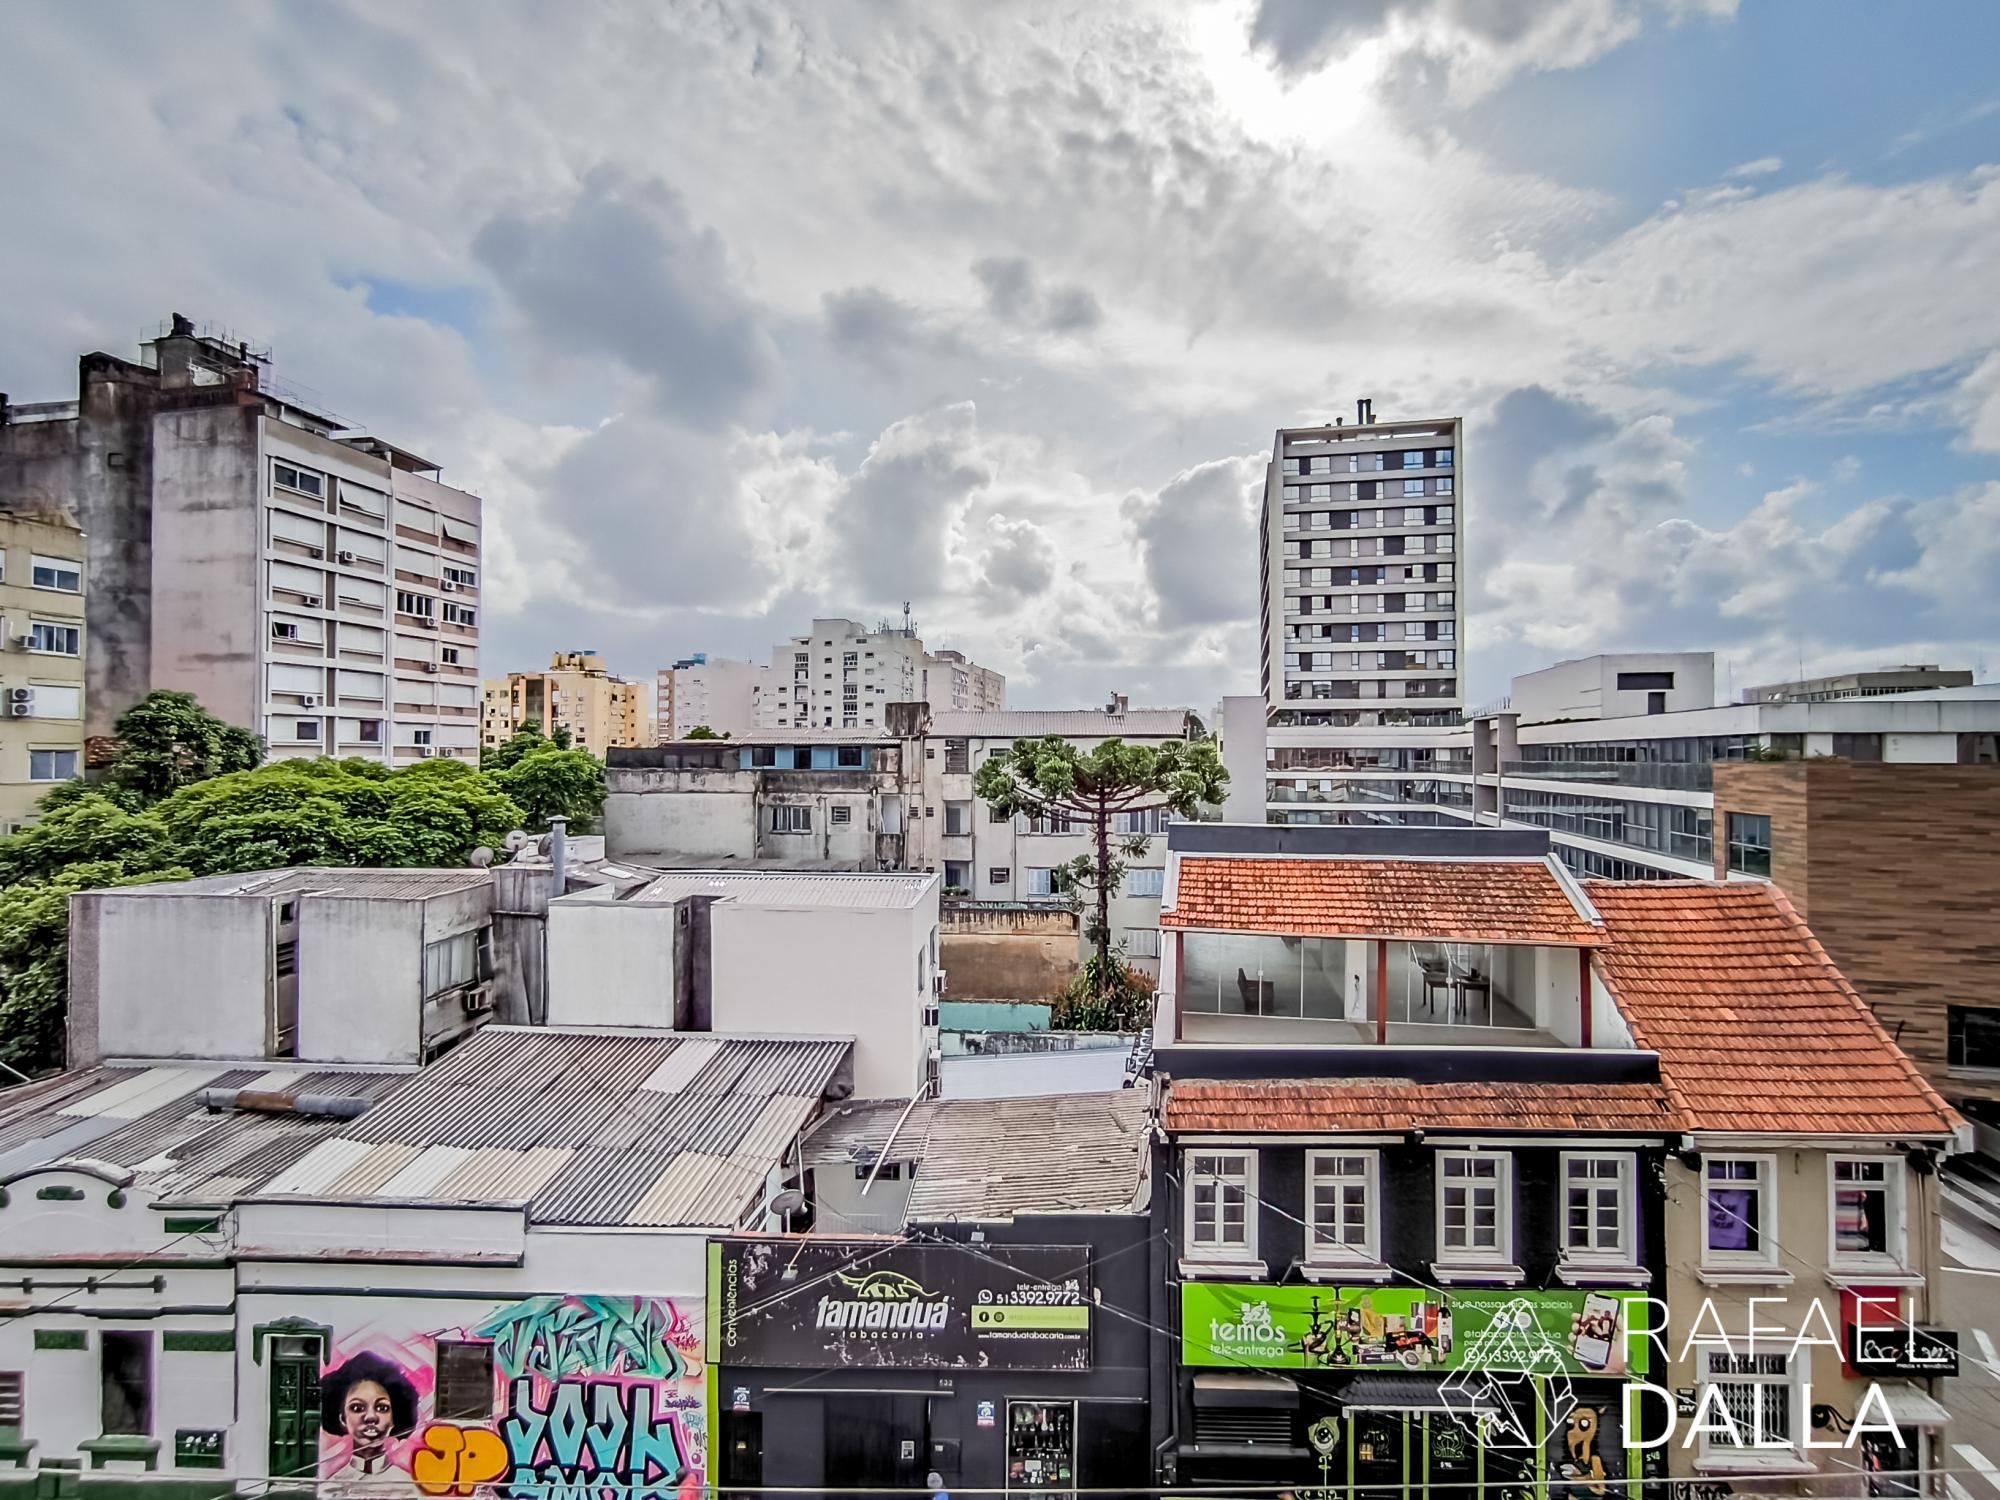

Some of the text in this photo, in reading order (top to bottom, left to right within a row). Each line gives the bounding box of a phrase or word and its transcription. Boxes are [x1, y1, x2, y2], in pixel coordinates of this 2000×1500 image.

[815, 1295, 950, 1329] tamanduá
[842, 1330, 924, 1339] tabacaria
[1209, 1318, 1286, 1342] temos
[1210, 1344, 1285, 1358] tele-entrega
